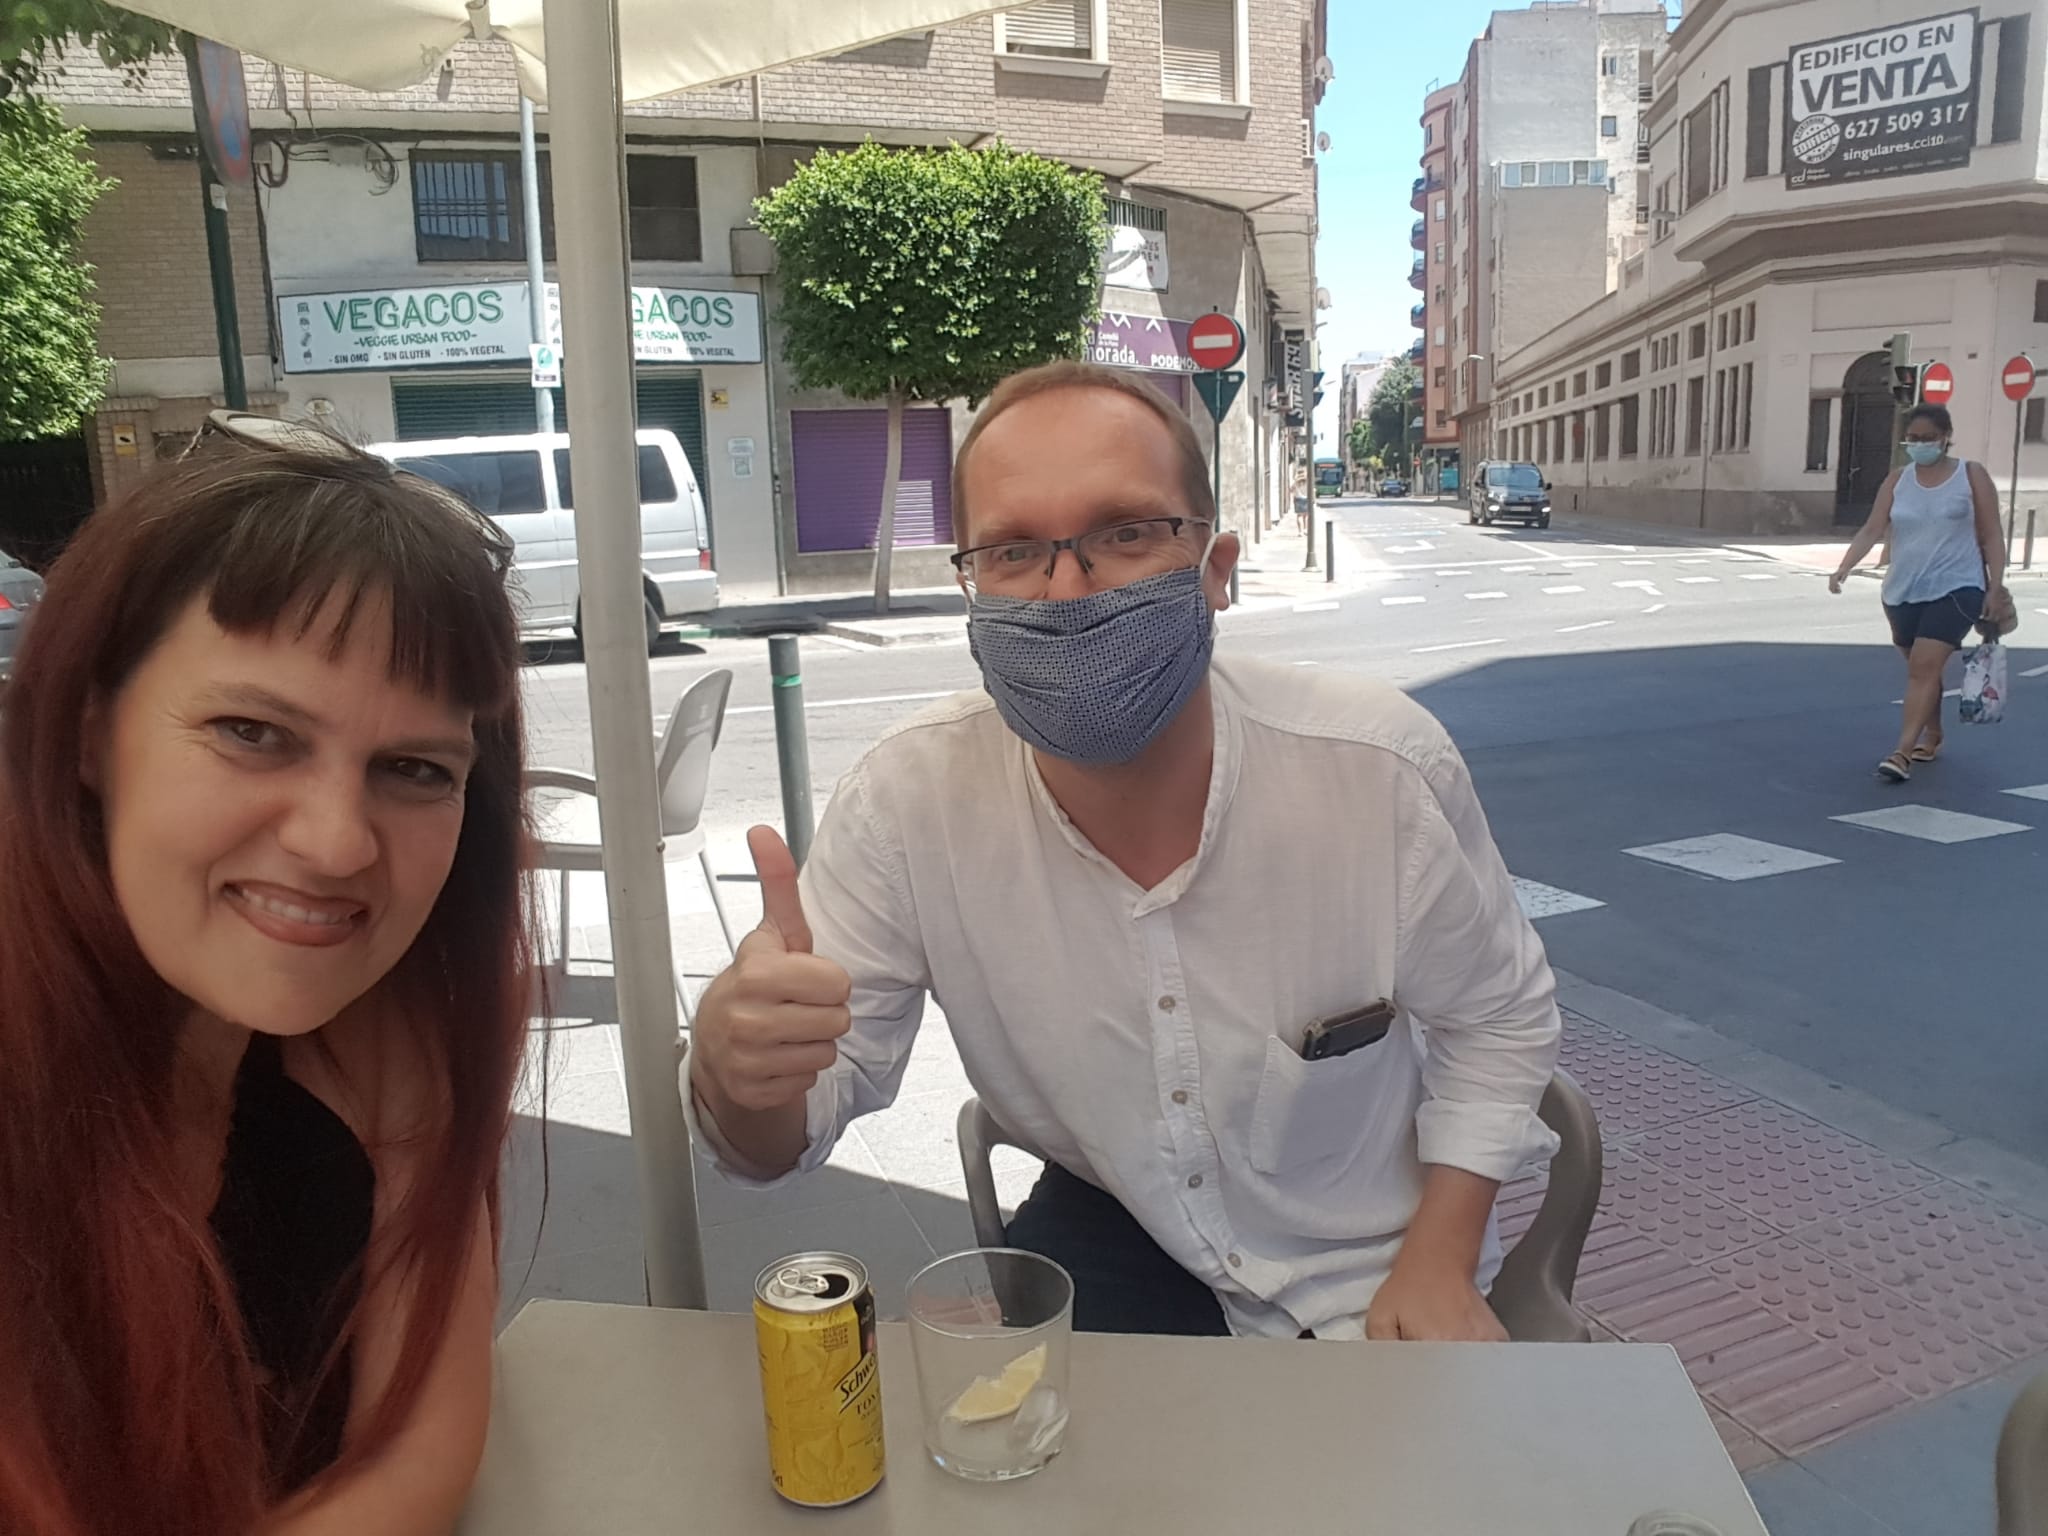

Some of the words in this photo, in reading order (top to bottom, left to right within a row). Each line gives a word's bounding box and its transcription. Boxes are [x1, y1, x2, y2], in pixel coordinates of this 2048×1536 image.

[1800, 34, 1908, 72] EDIFICIO
[1918, 24, 1954, 49] EN
[1800, 52, 1958, 113] VENTA
[1844, 118, 1880, 139] 627
[1886, 111, 1923, 134] 509
[1930, 103, 1969, 127] 317
[323, 289, 504, 333] VEGACOS
[632, 293, 735, 328] GACOS
[334, 354, 348, 364] SIN
[350, 353, 369, 363] OMG
[383, 351, 399, 361] SIN
[400, 349, 431, 360] GLUTEN
[445, 347, 468, 357] 100%
[470, 344, 505, 356] VEGETAL
[402, 332, 438, 345] URBAN
